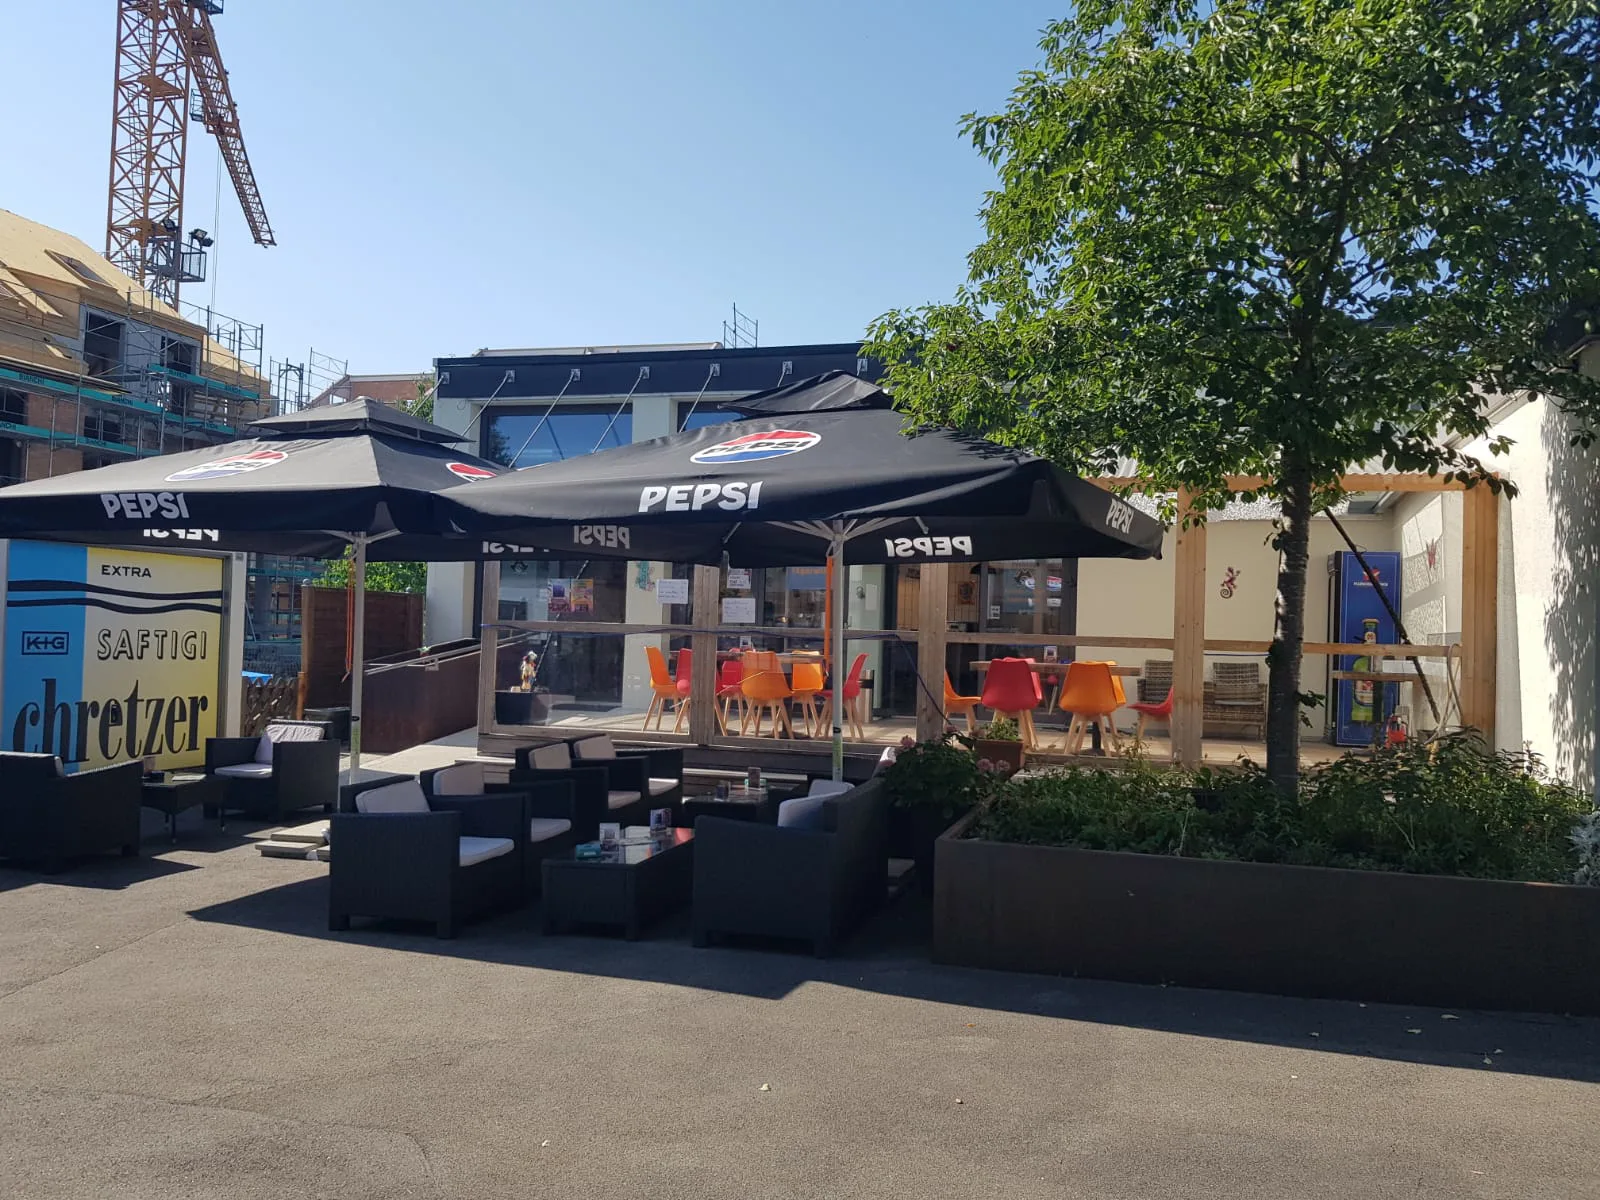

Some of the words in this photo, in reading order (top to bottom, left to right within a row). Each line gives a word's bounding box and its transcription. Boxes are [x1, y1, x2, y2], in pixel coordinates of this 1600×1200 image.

[702, 441, 812, 455] PEPSI
[101, 491, 190, 519] PEPSI
[638, 481, 763, 512] PEPSI
[1105, 498, 1135, 535] PEPSI
[101, 564, 152, 578] EXTRA
[97, 628, 208, 660] SAFTIGI
[13, 678, 208, 764] chretzer
